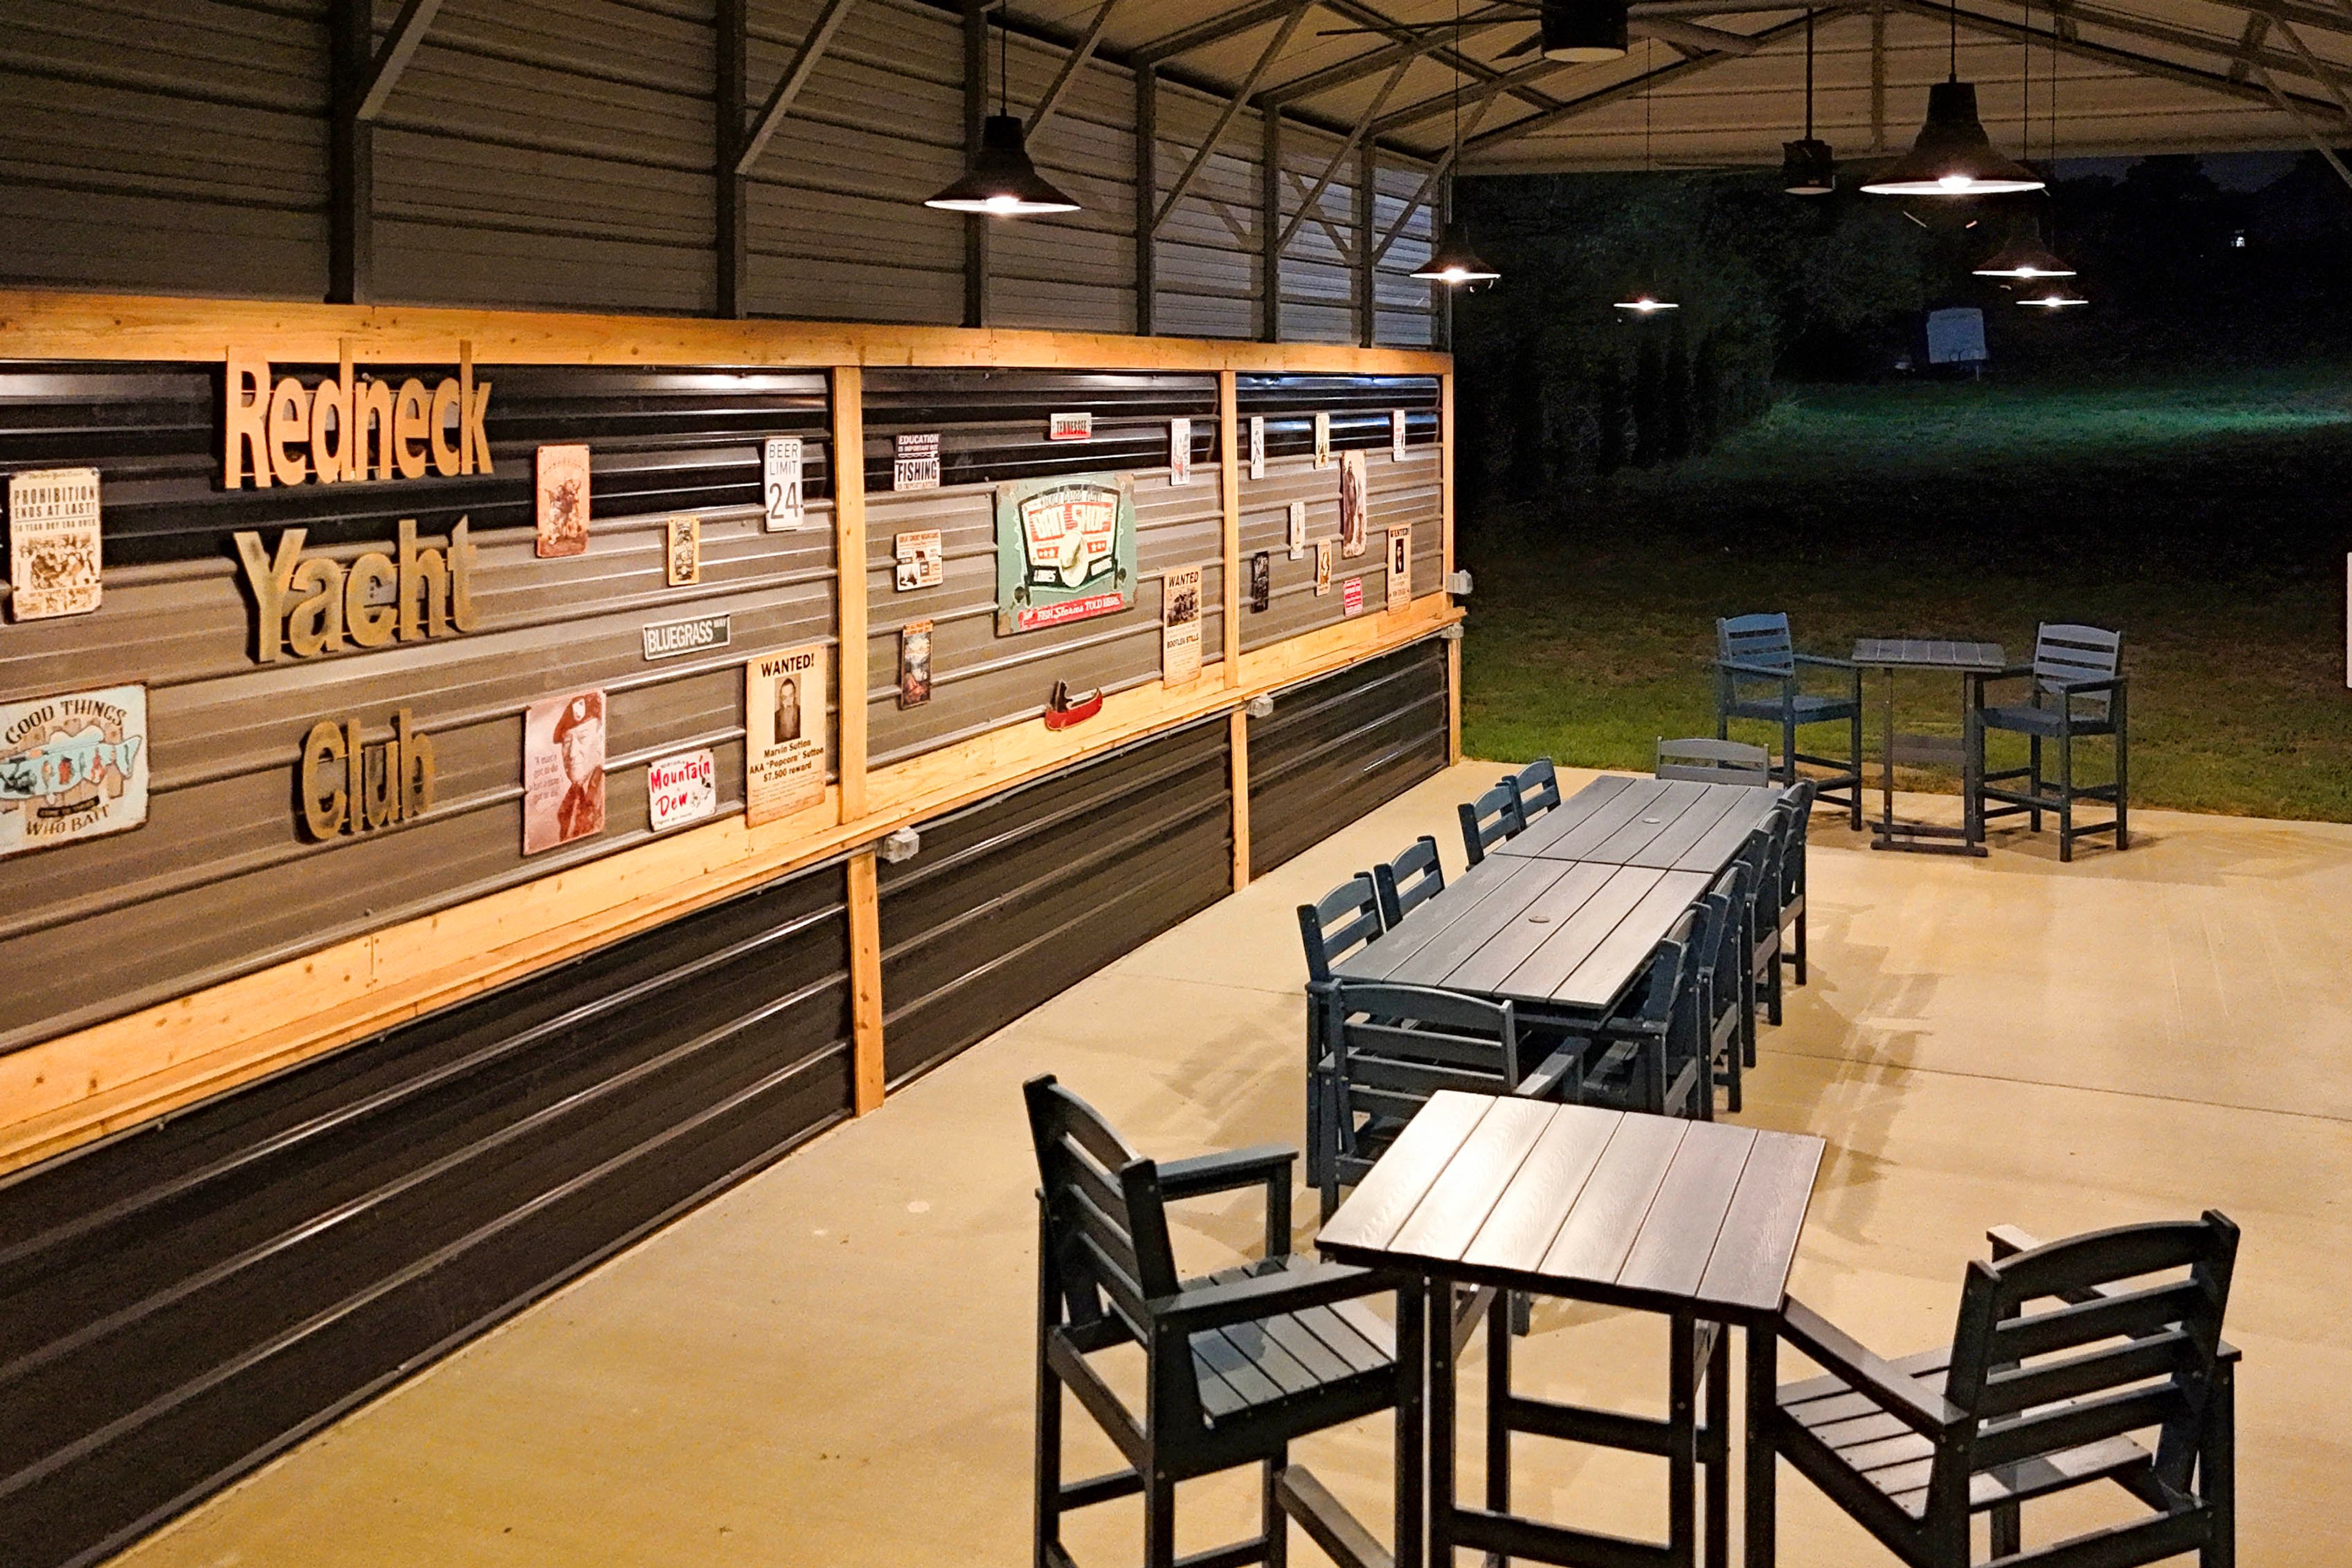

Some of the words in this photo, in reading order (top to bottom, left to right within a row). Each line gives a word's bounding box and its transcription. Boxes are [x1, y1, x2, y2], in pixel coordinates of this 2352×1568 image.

[225, 337, 494, 489] Redneck
[899, 434, 939, 445] EDUCATION
[1057, 420, 1087, 435] TENNESSEE
[769, 443, 798, 458] BEER
[769, 460, 797, 475] LIMIT
[895, 460, 937, 482] FISHING
[14, 485, 95, 506] PROHIBITION
[769, 481, 799, 519] 24
[15, 505, 42, 519] ENDS
[47, 504, 60, 516] AT
[1031, 506, 1066, 540] BAIT
[1071, 503, 1113, 533] SHOP
[233, 514, 477, 663] Yacht
[1169, 571, 1199, 589] WANTED
[1038, 609, 1053, 621] FISH
[1085, 600, 1102, 611] TOLD
[647, 620, 714, 654] BLUEGRASS
[761, 653, 815, 678] WANTED!
[6, 705, 55, 745] GOOD
[60, 699, 127, 727] THINGS
[750, 763, 764, 775] AKA
[802, 747, 824, 759] Sutton
[764, 745, 788, 758] Marvin
[789, 739, 812, 752] Sutton
[303, 708, 435, 839] Club
[650, 755, 710, 794] Mountain
[788, 760, 812, 775] reward
[655, 791, 688, 816] Dew
[26, 816, 66, 836] WHO
[70, 804, 110, 832] BAIT
